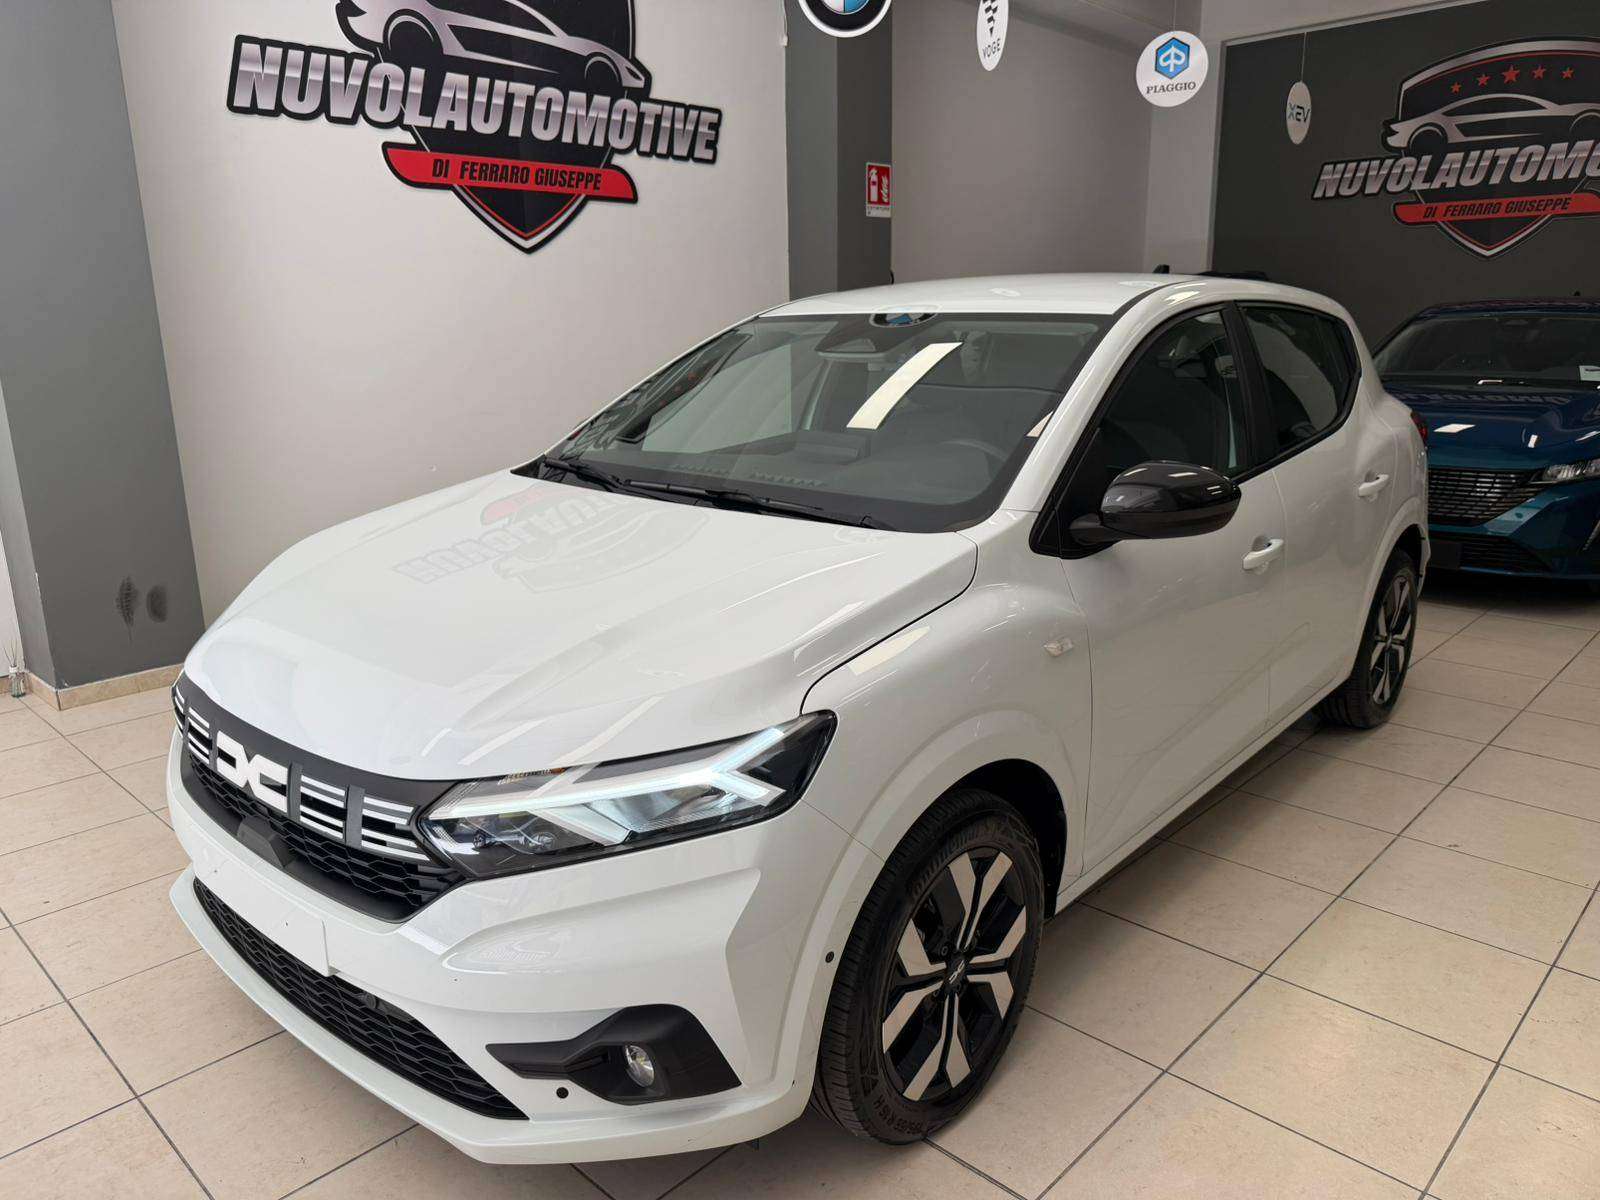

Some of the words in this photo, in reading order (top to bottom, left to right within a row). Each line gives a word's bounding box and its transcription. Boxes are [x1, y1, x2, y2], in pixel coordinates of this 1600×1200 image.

[982, 37, 1001, 59] VOGE
[1145, 81, 1197, 95] PIAGGIO
[232, 41, 721, 162] NUVOLAUTOMOTIVE
[1287, 102, 1312, 124] XEV
[432, 158, 450, 178] DI
[459, 160, 531, 185] FERRARO
[534, 167, 602, 191] GIUSEPPE
[1423, 205, 1438, 219] DI
[1442, 201, 1503, 218] FERRARO
[1504, 197, 1572, 215] GIUSEPPE
